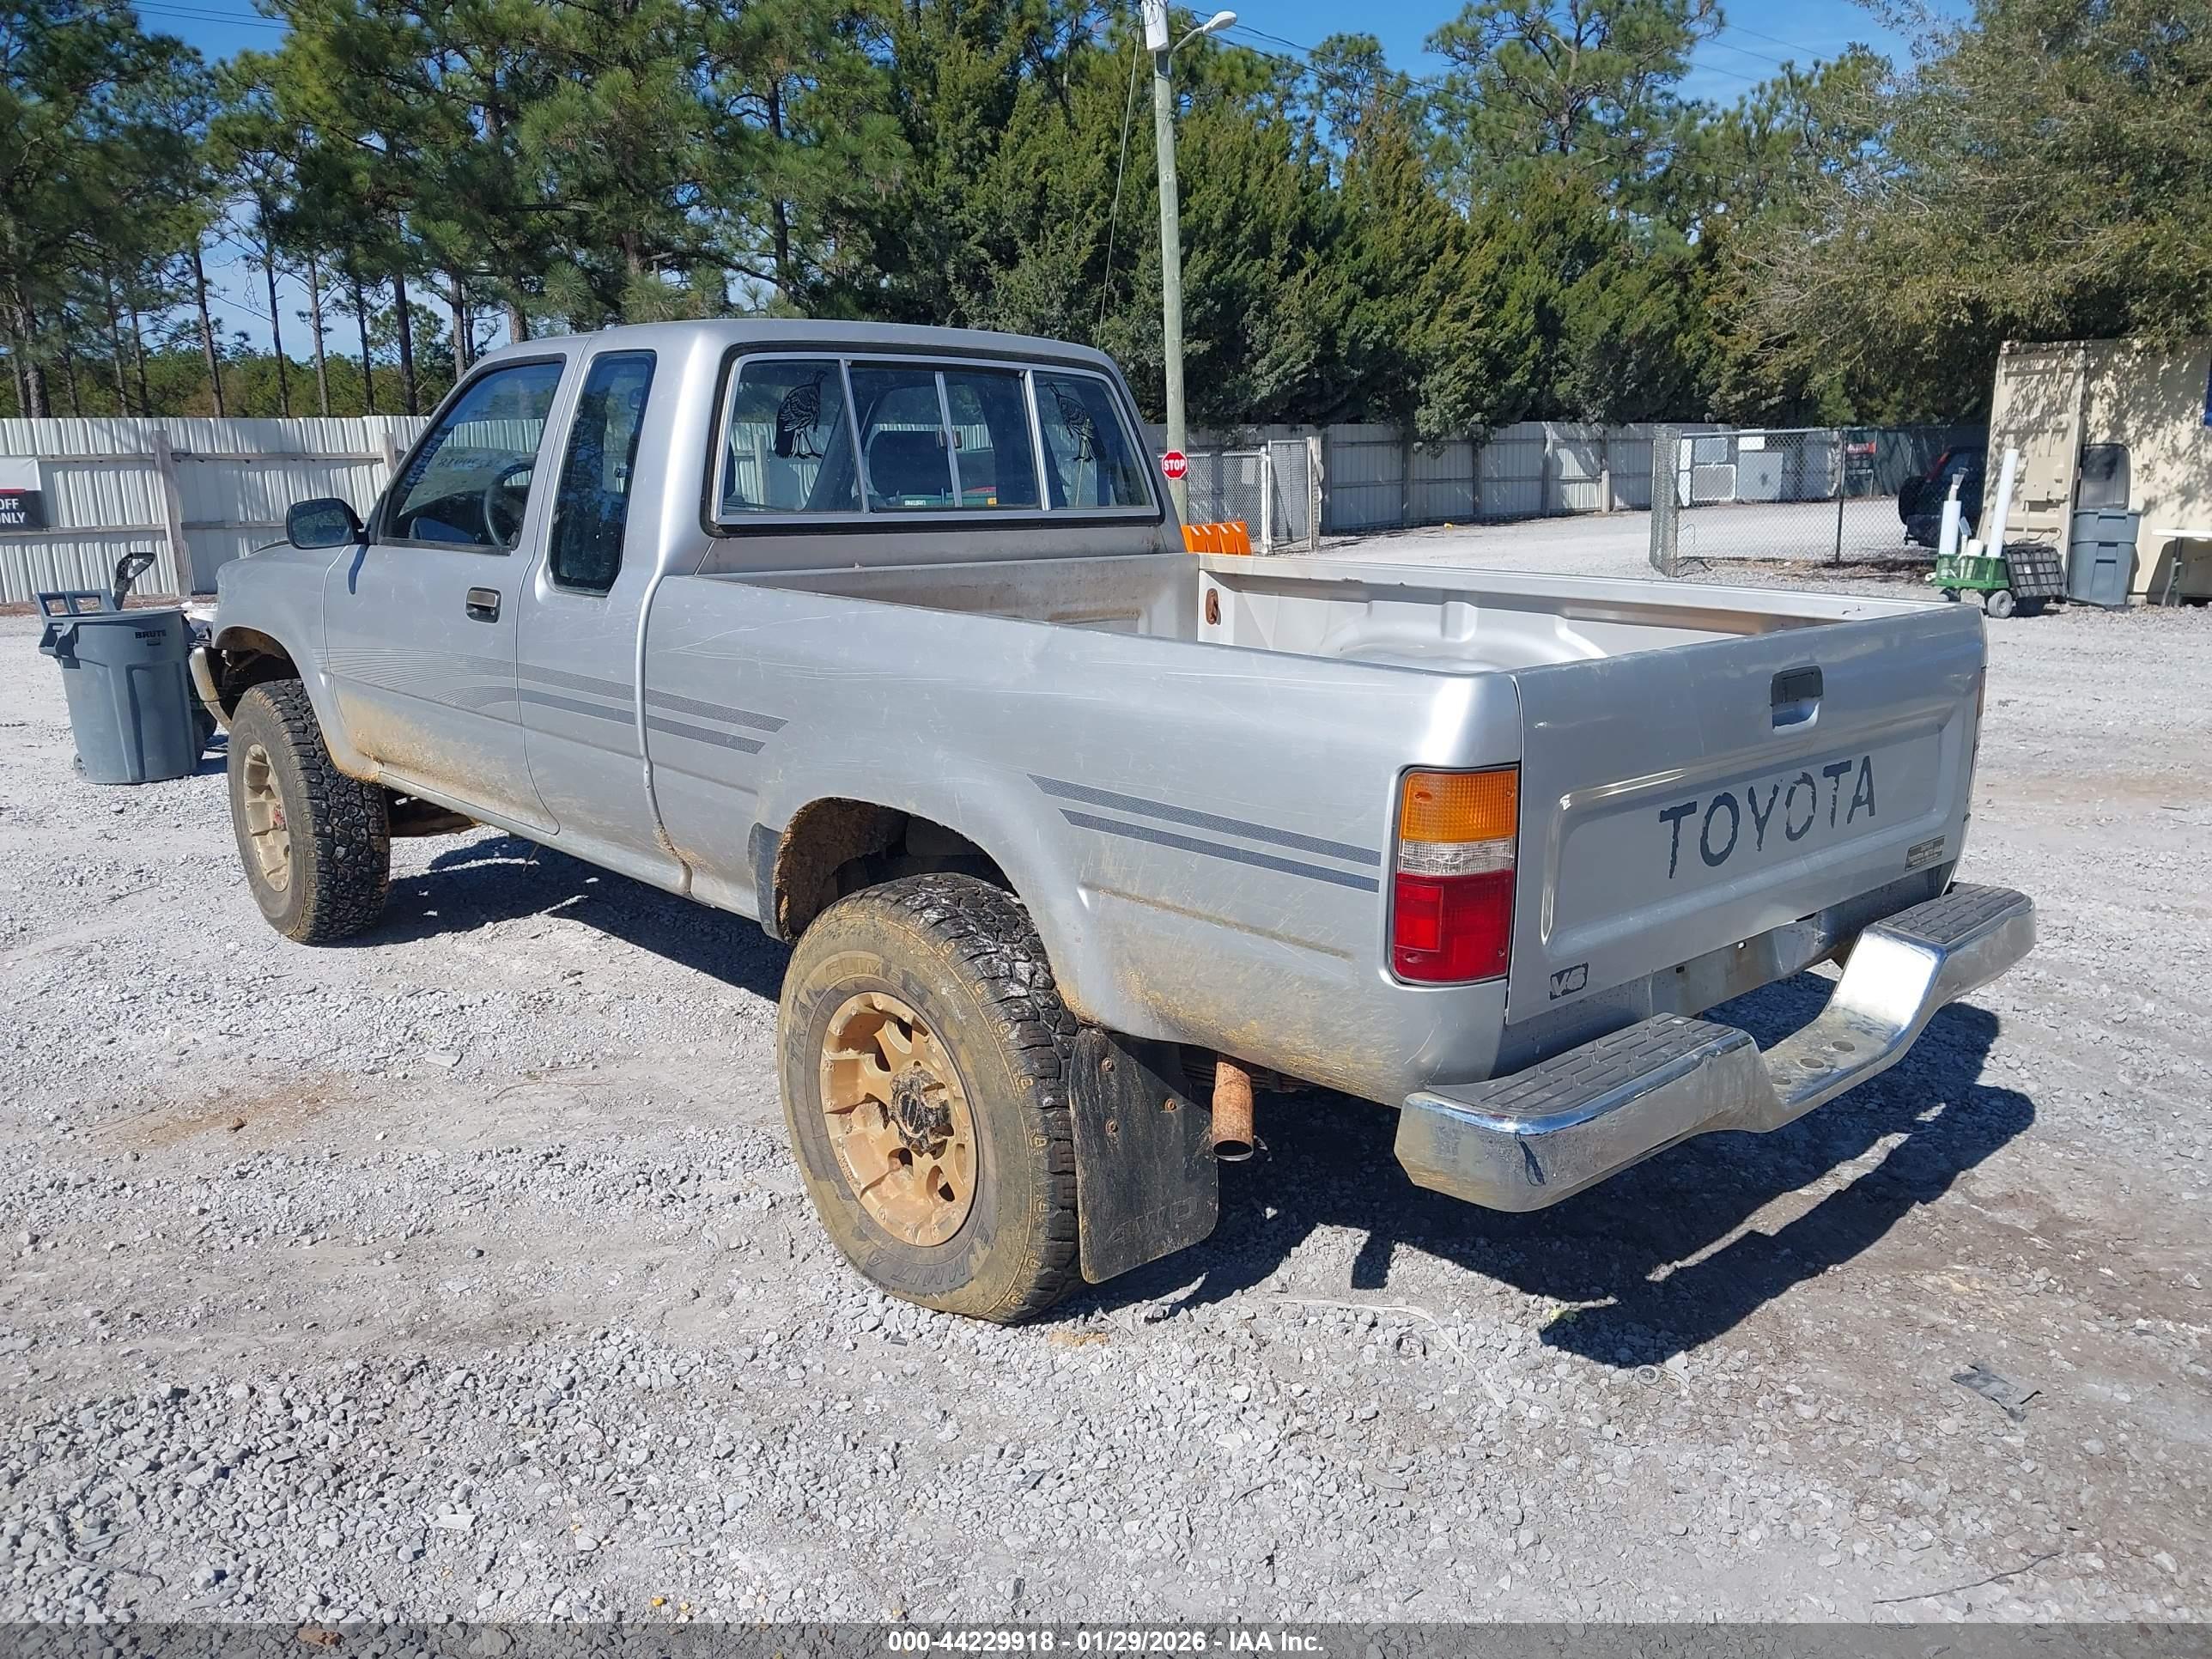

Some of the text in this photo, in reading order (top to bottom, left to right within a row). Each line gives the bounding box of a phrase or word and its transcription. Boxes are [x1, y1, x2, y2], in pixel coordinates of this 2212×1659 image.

[1164, 459, 1185, 471] STOP
[0, 512, 25, 524] NLY
[1659, 755, 1875, 879] TOYOTA
